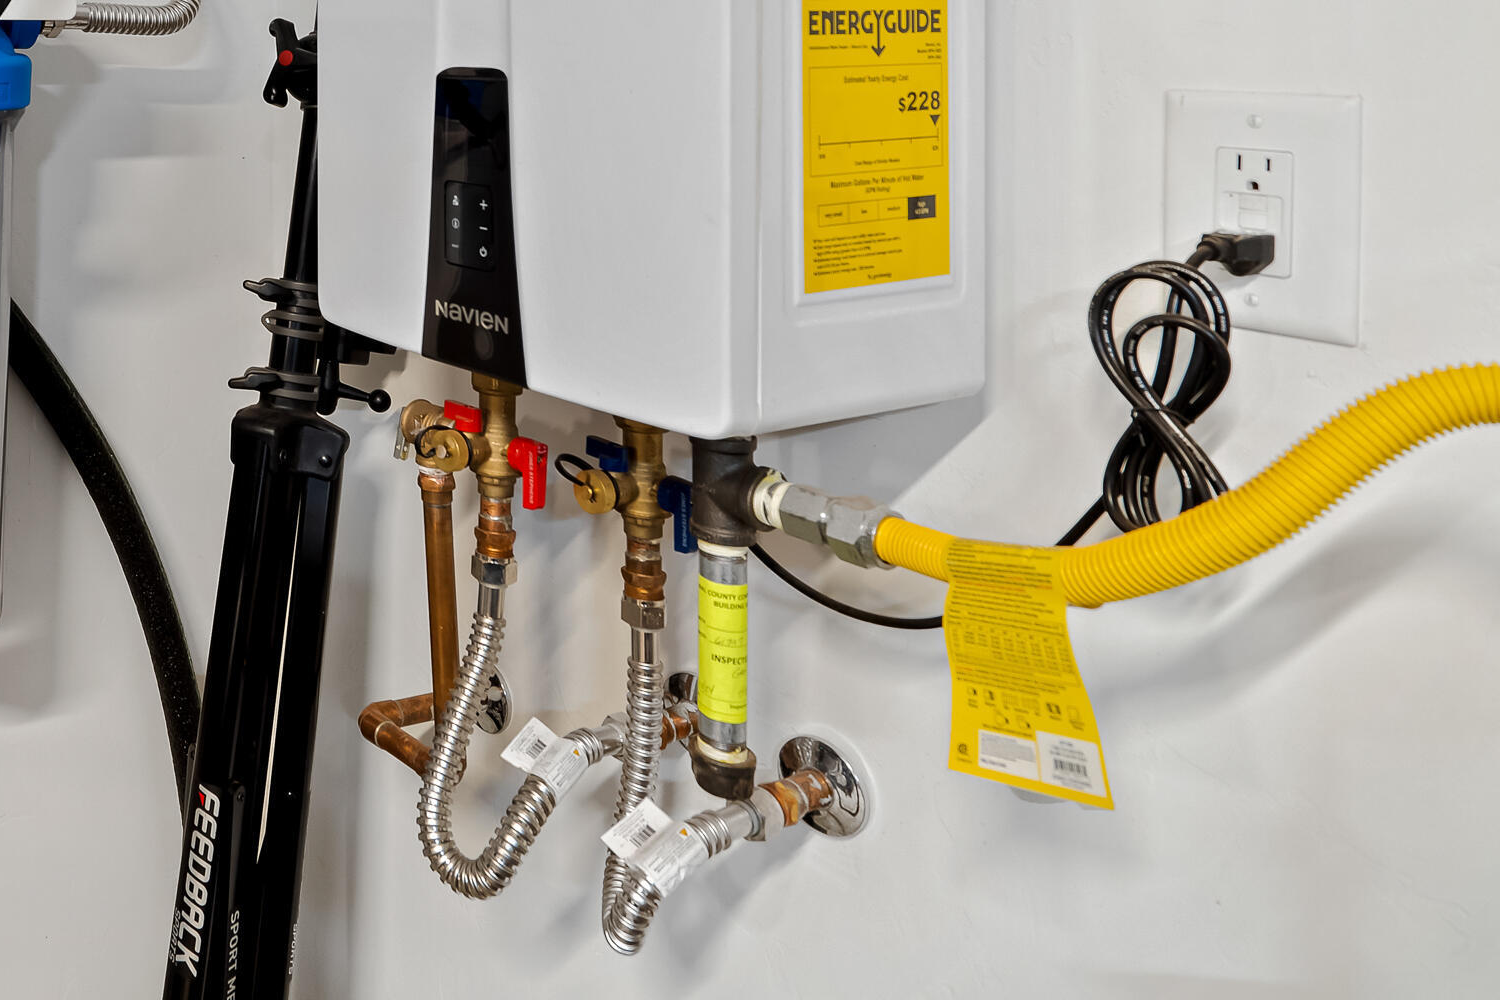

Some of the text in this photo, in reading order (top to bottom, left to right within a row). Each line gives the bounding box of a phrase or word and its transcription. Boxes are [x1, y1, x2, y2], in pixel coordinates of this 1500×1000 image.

[808, 9, 941, 37] ENERGYGUIDE
[898, 91, 941, 112] $228
[707, 589, 737, 600] COUNTY
[175, 783, 221, 978] FEEDBACK
[168, 907, 182, 964] SPORTS
[227, 910, 240, 972] SPORT
